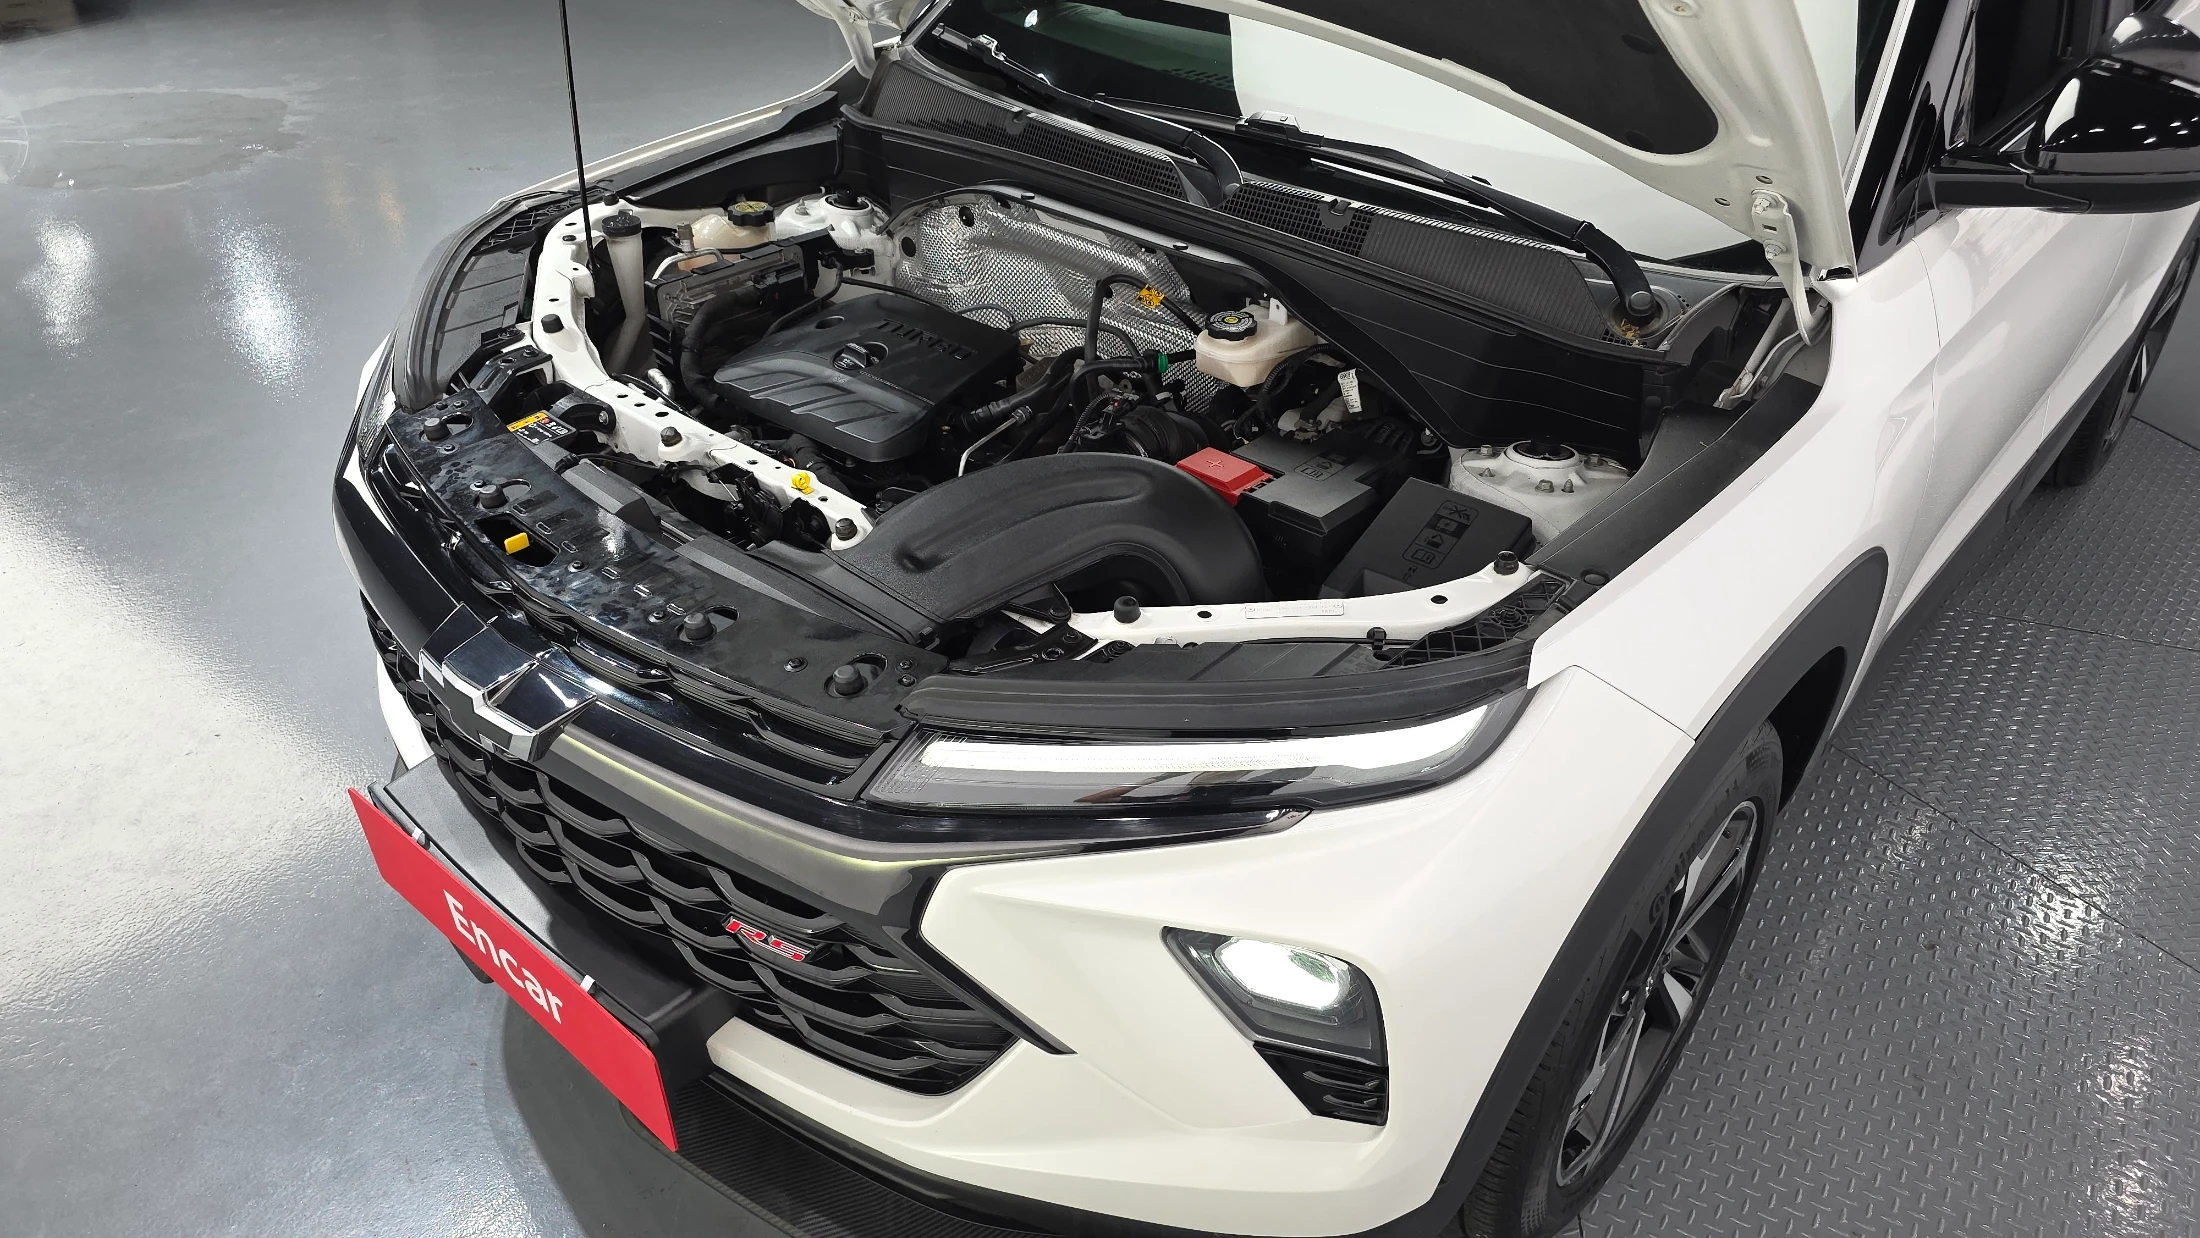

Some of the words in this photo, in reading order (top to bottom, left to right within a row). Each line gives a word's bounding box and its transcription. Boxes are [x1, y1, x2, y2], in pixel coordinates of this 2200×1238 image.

[1648, 785, 1735, 925] Continetl
[443, 889, 563, 1024] Encar
[726, 917, 811, 962] RS
